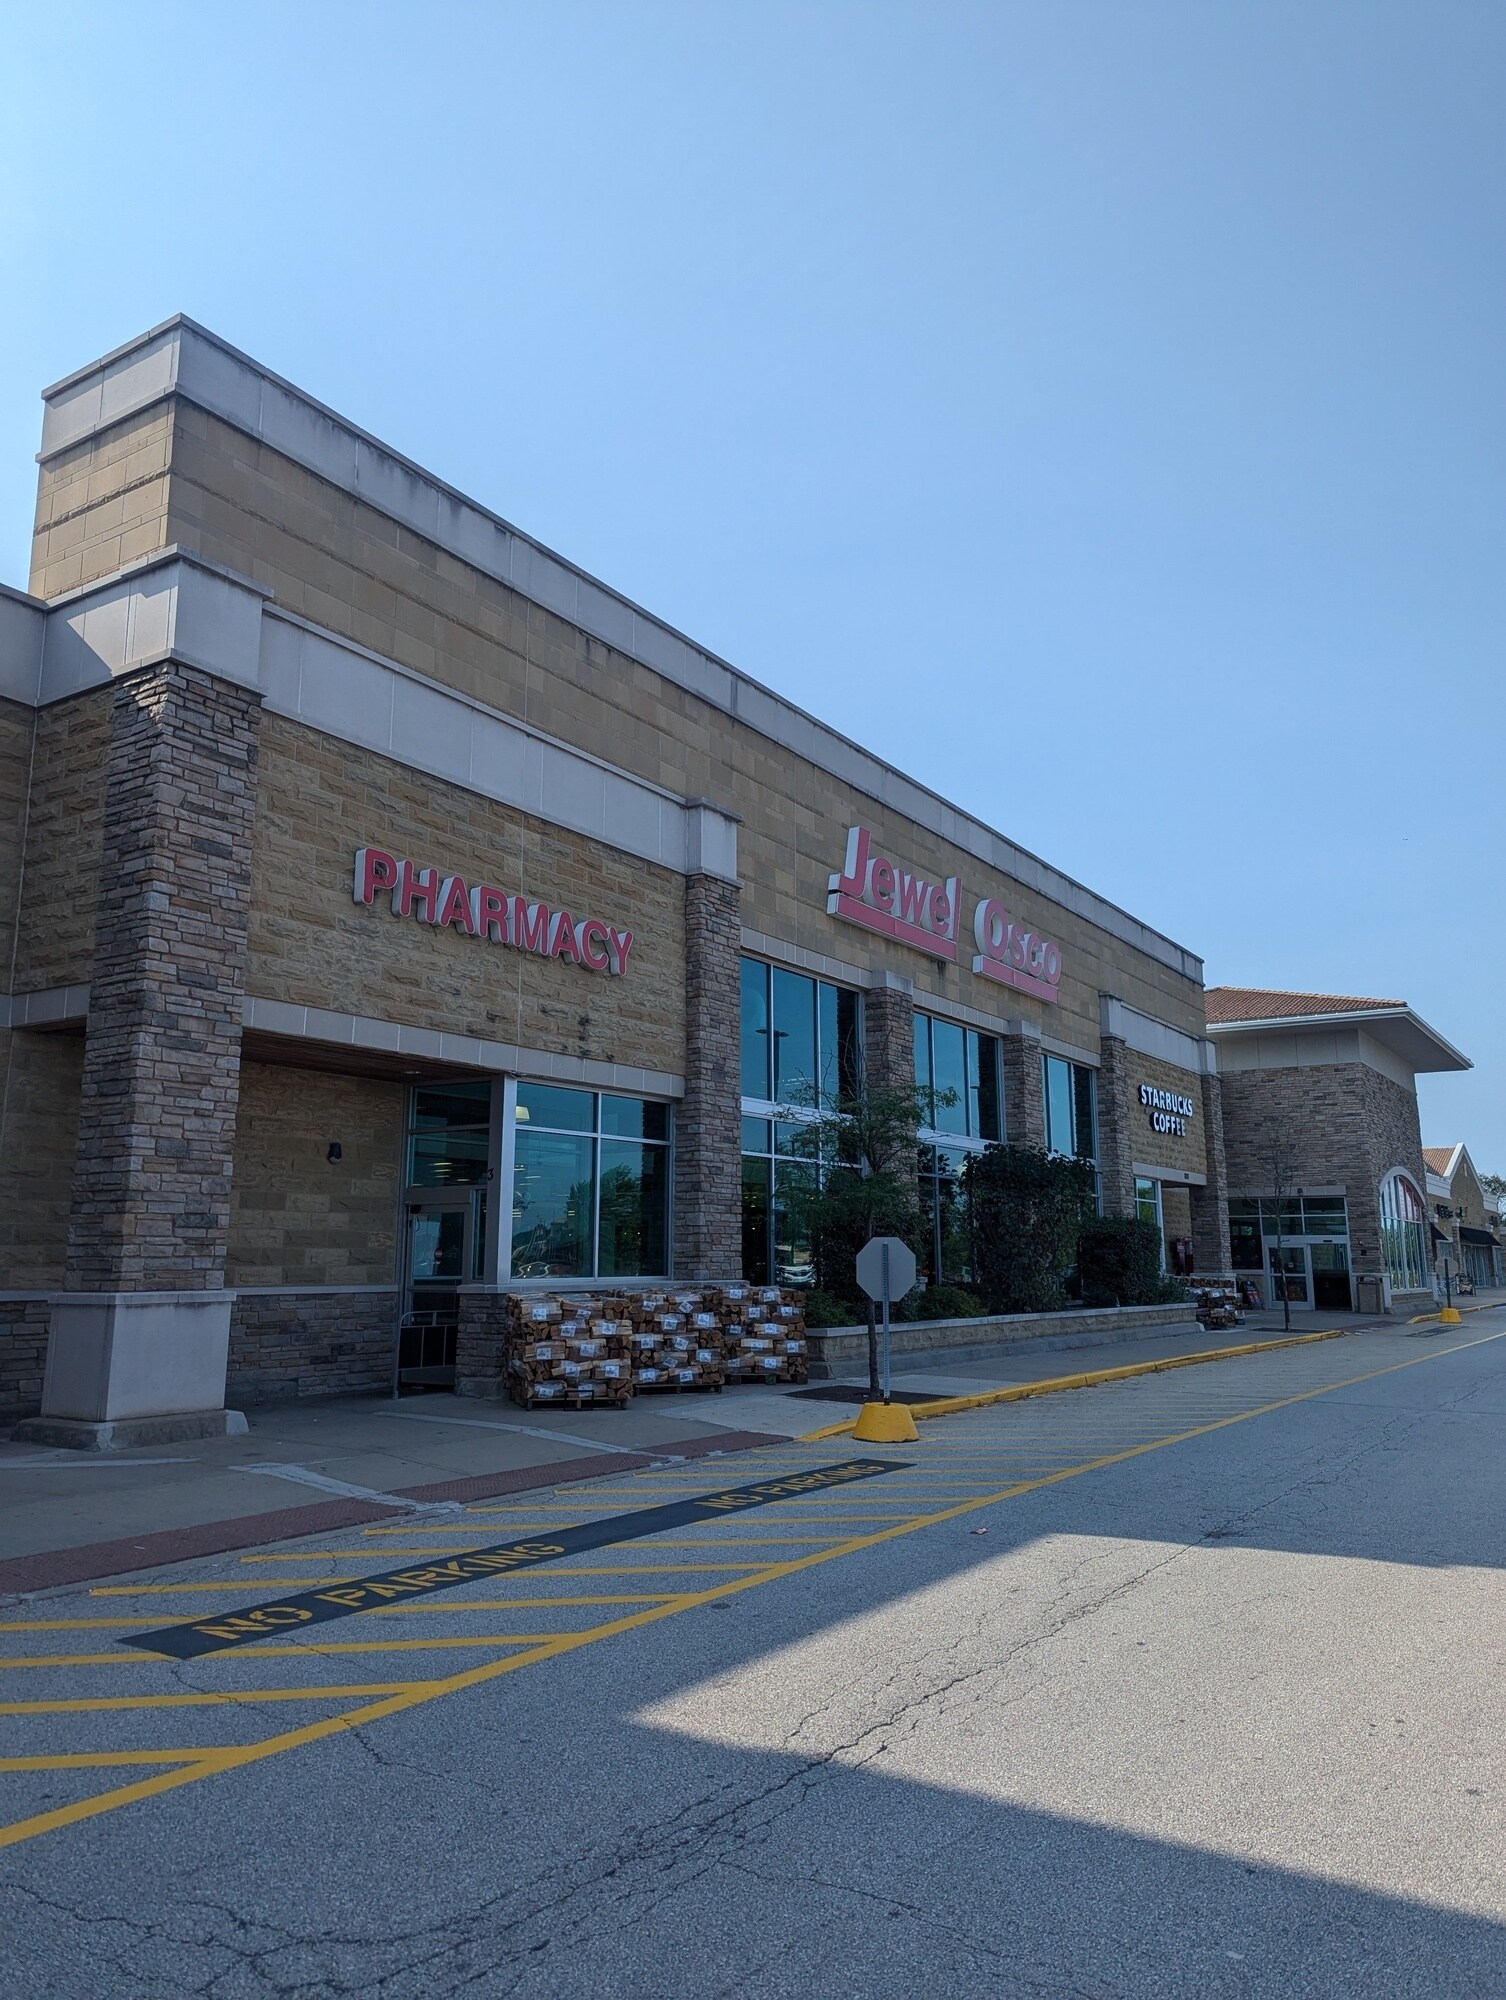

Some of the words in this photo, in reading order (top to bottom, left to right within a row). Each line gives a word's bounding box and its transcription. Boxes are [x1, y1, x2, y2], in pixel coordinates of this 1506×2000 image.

[354, 847, 634, 977] PHARMACY
[828, 825, 963, 943] Jewel
[974, 897, 1062, 986] Osco
[1139, 1084, 1194, 1117] STARBUCKS
[1152, 1111, 1187, 1137] COFFEE
[693, 1493, 764, 1510] NO
[749, 1464, 886, 1496] PARKING
[191, 1605, 314, 1641] NO
[313, 1542, 566, 1607] PARKING
